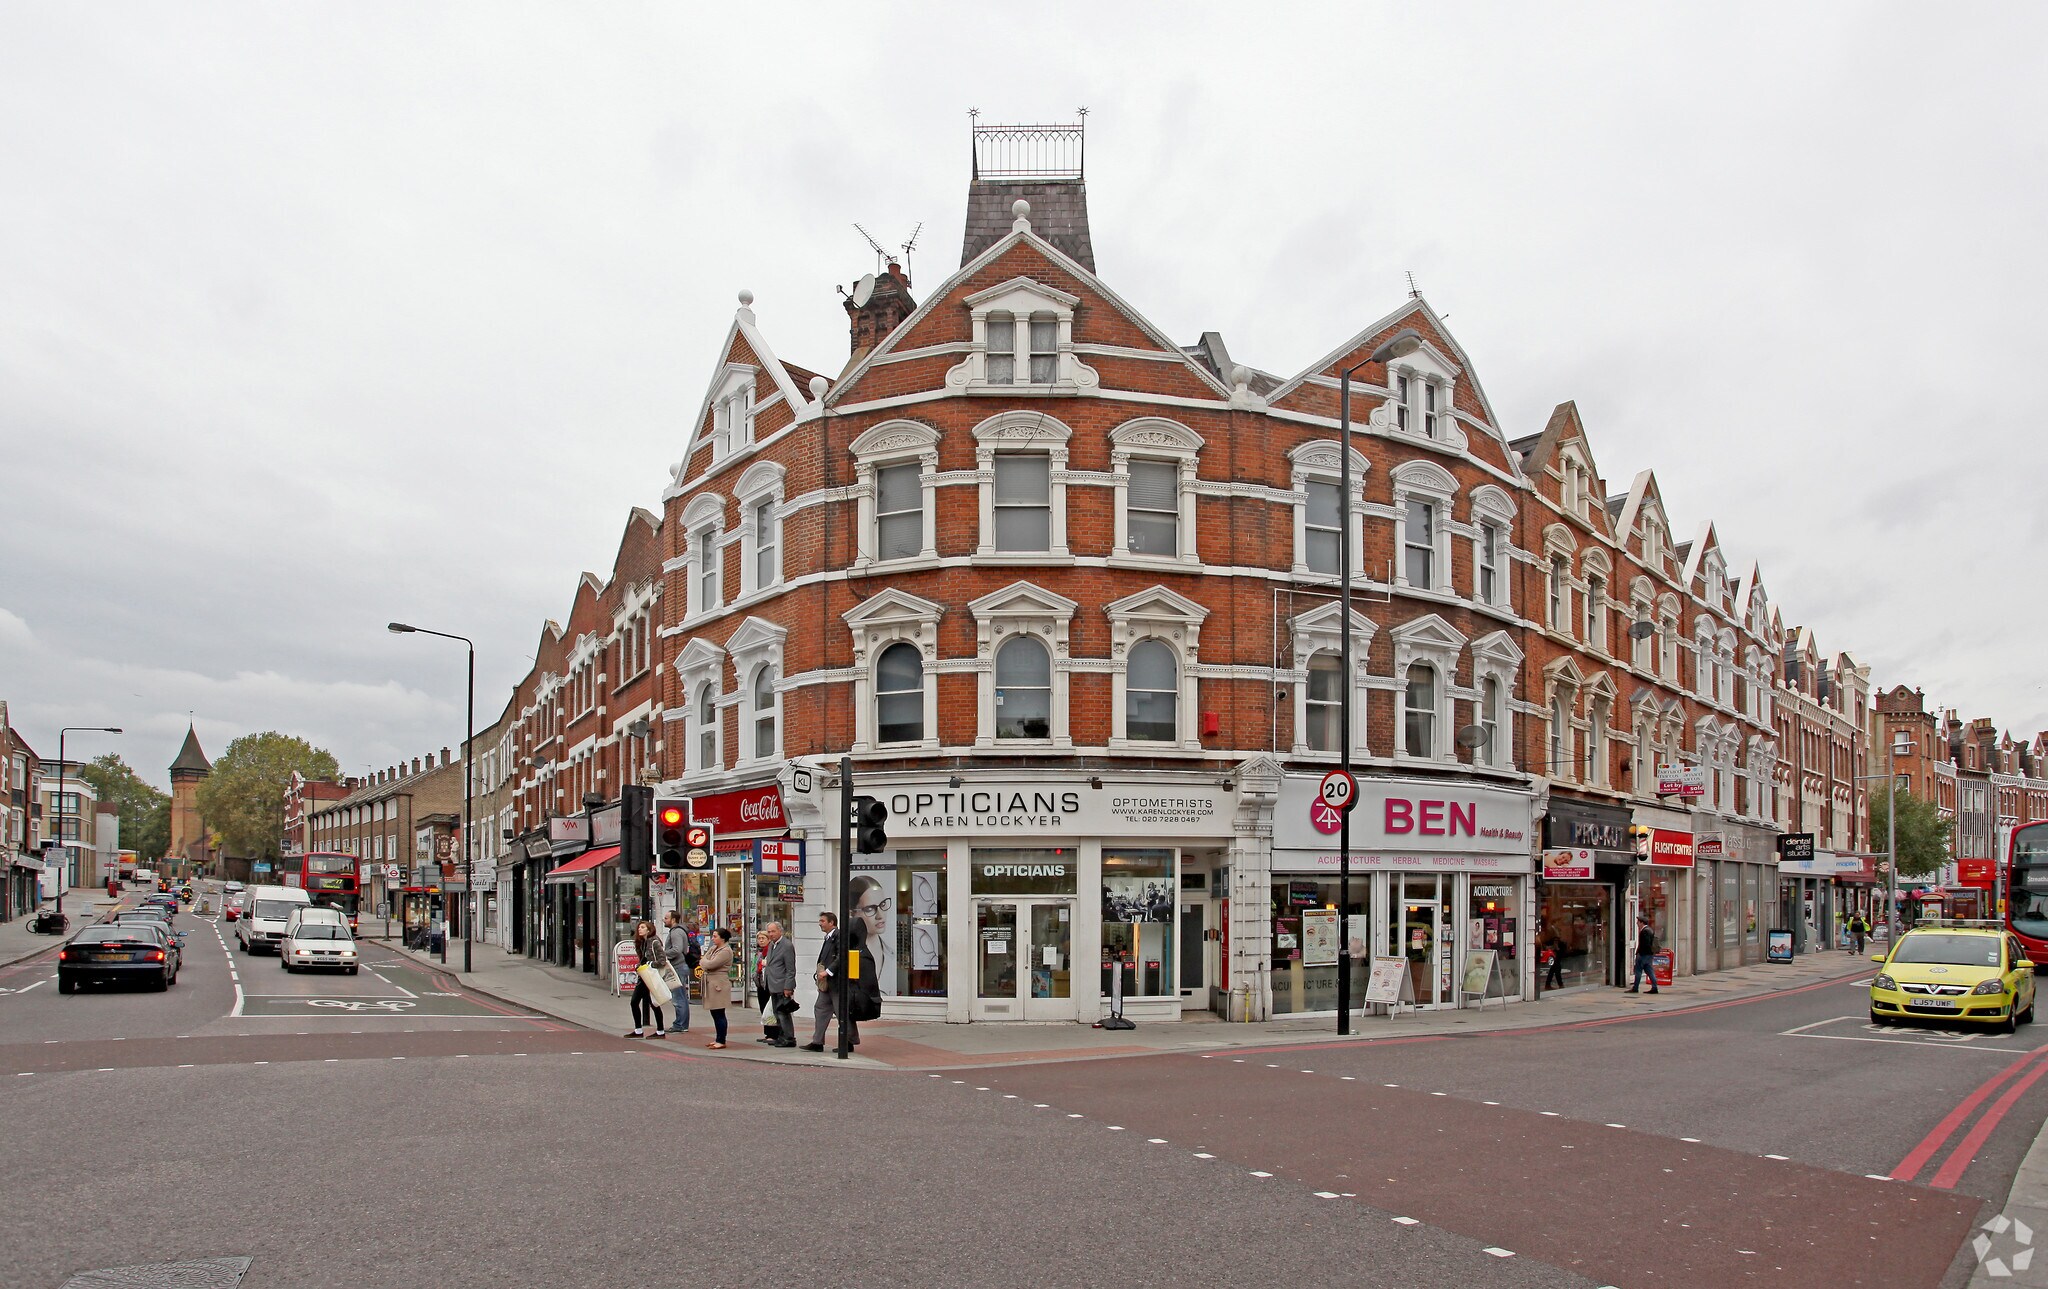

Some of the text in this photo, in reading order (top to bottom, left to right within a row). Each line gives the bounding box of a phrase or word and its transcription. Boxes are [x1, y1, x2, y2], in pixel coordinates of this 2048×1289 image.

[797, 778, 809, 787] KL
[1325, 782, 1348, 798] 20
[892, 792, 1080, 814] OPTICIANS
[1112, 798, 1213, 808] OPTOMETRISTS
[908, 816, 1061, 826] KAREN LOCKYER
[1385, 798, 1476, 836] BEN
[1480, 826, 1498, 837] Health
[1504, 828, 1524, 841] Beauty
[762, 844, 778, 853] OFF
[1654, 842, 1692, 856] FLIGHT CENTRE
[1318, 856, 1380, 864] ACUPNCTURE
[1392, 856, 1422, 864] HERBAL
[1432, 857, 1464, 866] MEDICINE
[984, 865, 1065, 876] OPTICIANS
[1474, 886, 1512, 896] ACUPUNCTURE
